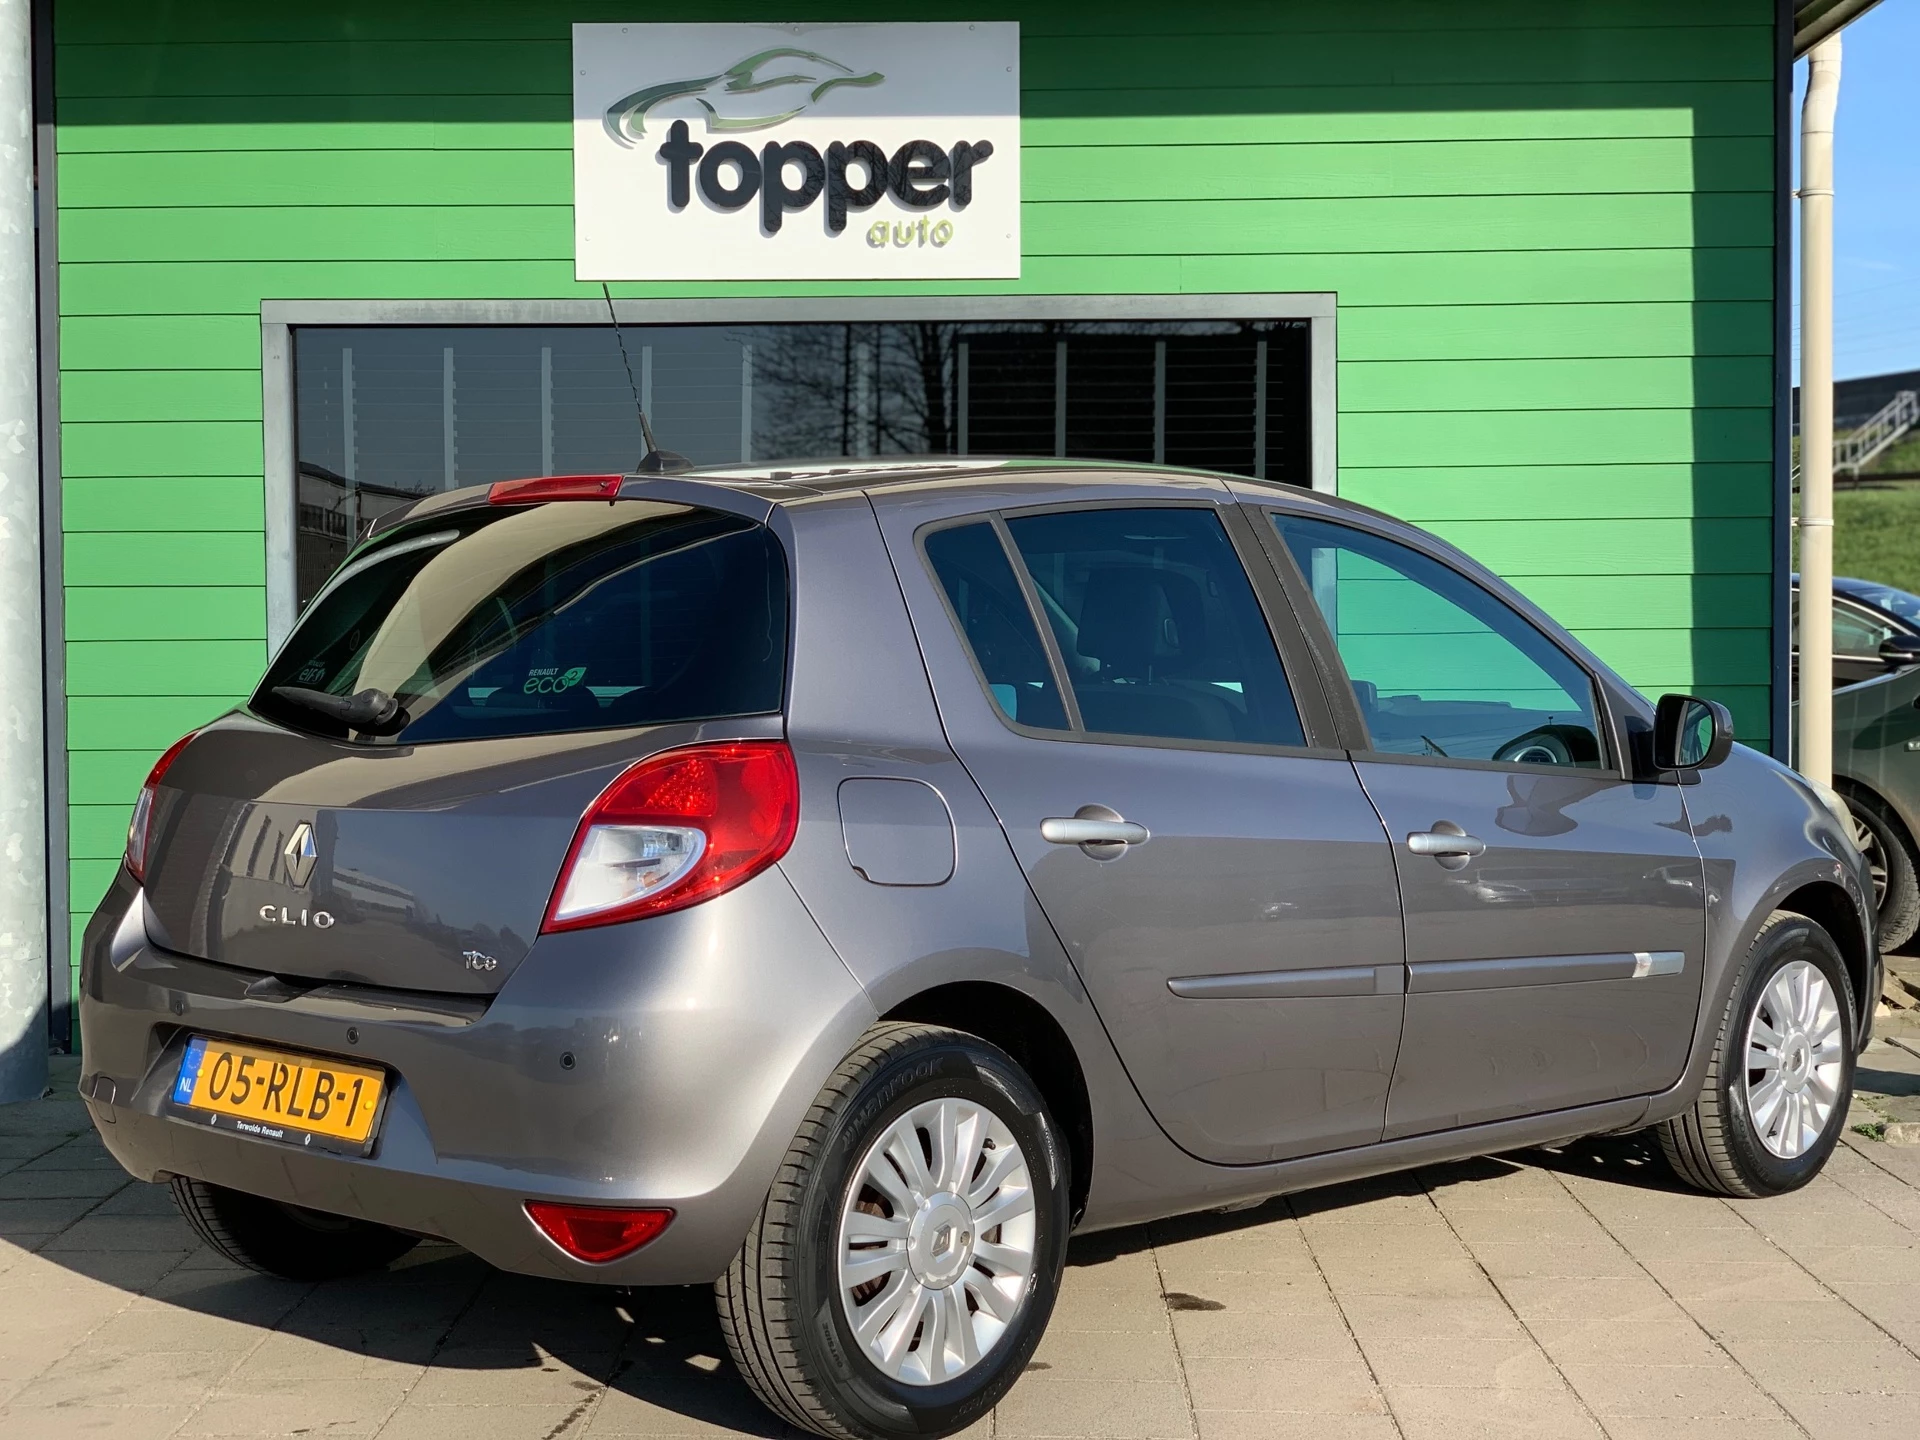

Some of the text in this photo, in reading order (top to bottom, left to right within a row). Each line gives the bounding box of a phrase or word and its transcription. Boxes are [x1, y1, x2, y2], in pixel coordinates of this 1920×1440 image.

[660, 119, 993, 232] topper
[869, 215, 954, 244] auto
[528, 667, 560, 677] RENAULT
[259, 904, 335, 929] CLIO
[179, 1076, 193, 1093] NL
[208, 1051, 364, 1127] 05-RLB-1
[236, 1120, 284, 1138] Terwolde Renault
[822, 1322, 843, 1368] OUTSIDE
